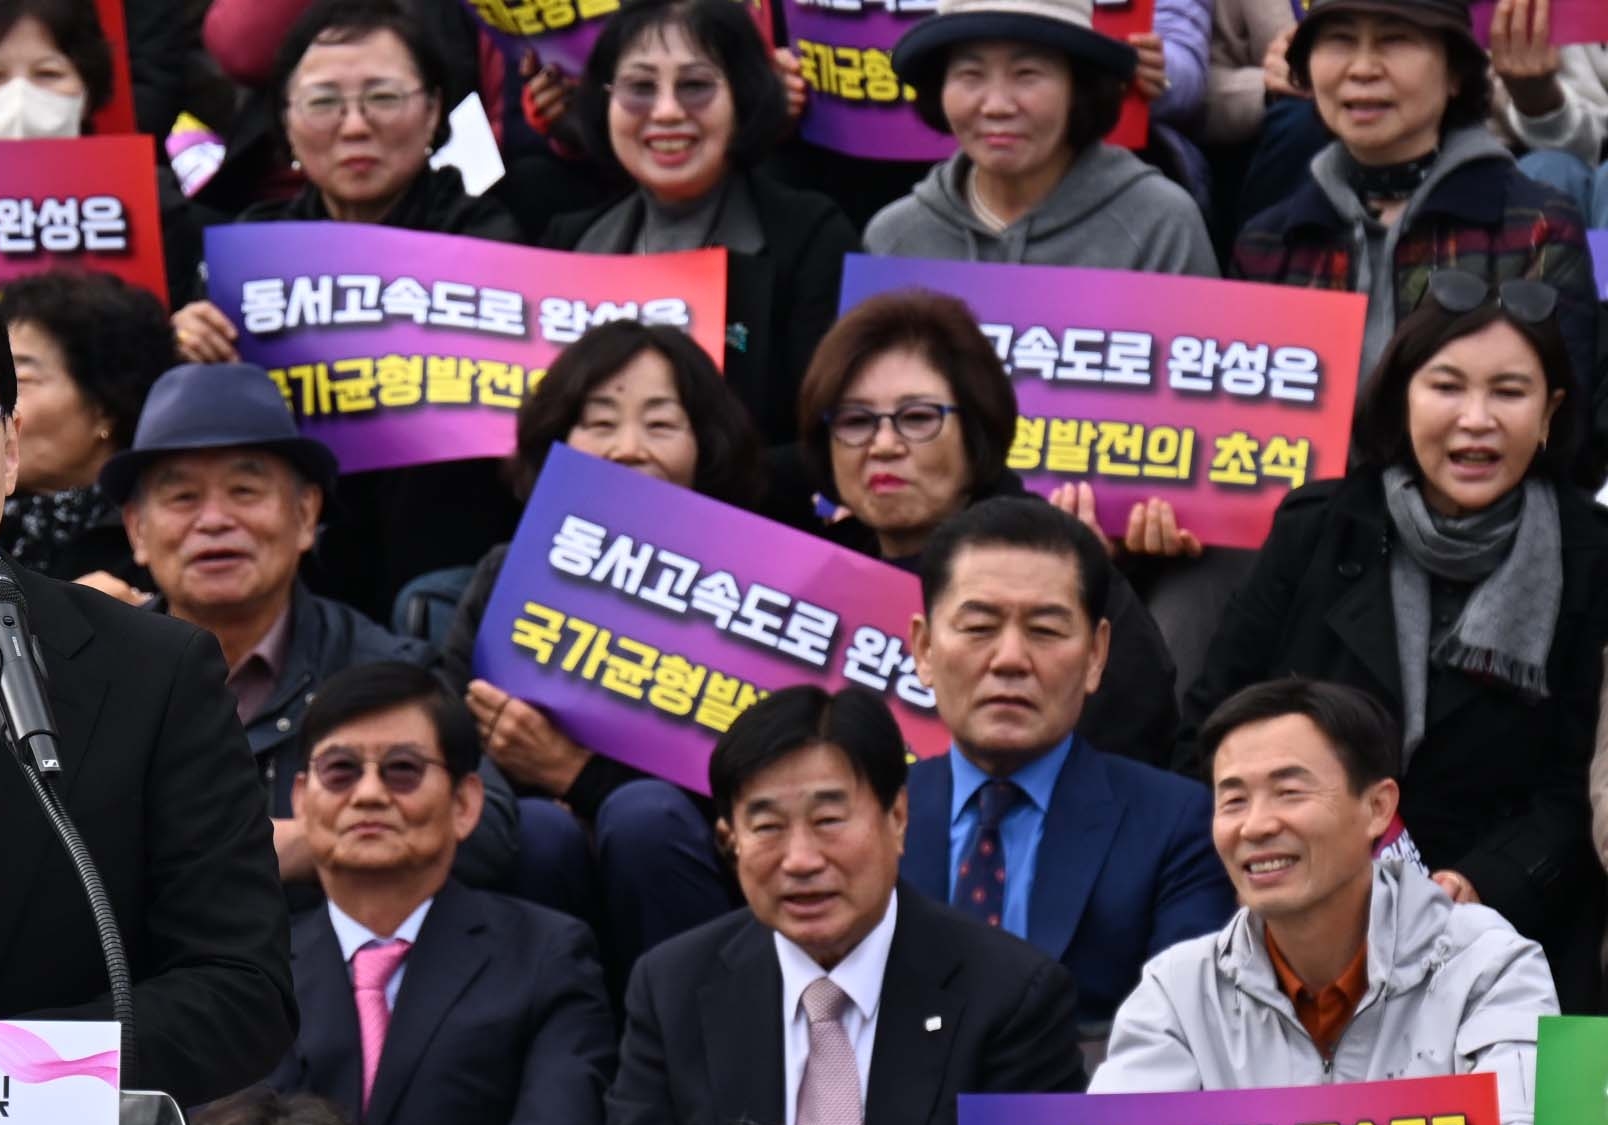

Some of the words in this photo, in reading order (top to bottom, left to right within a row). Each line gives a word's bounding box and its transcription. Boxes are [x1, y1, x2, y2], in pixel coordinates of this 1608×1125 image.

[796, 38, 917, 102] 국가균형
[241, 274, 526, 336] 동서고속도로
[267, 353, 547, 416] 가균형발전
[1167, 335, 1319, 401] 완성은
[1208, 431, 1310, 490] 초석
[548, 514, 839, 667] 동서고속도로
[511, 601, 770, 733] 국가균형발
